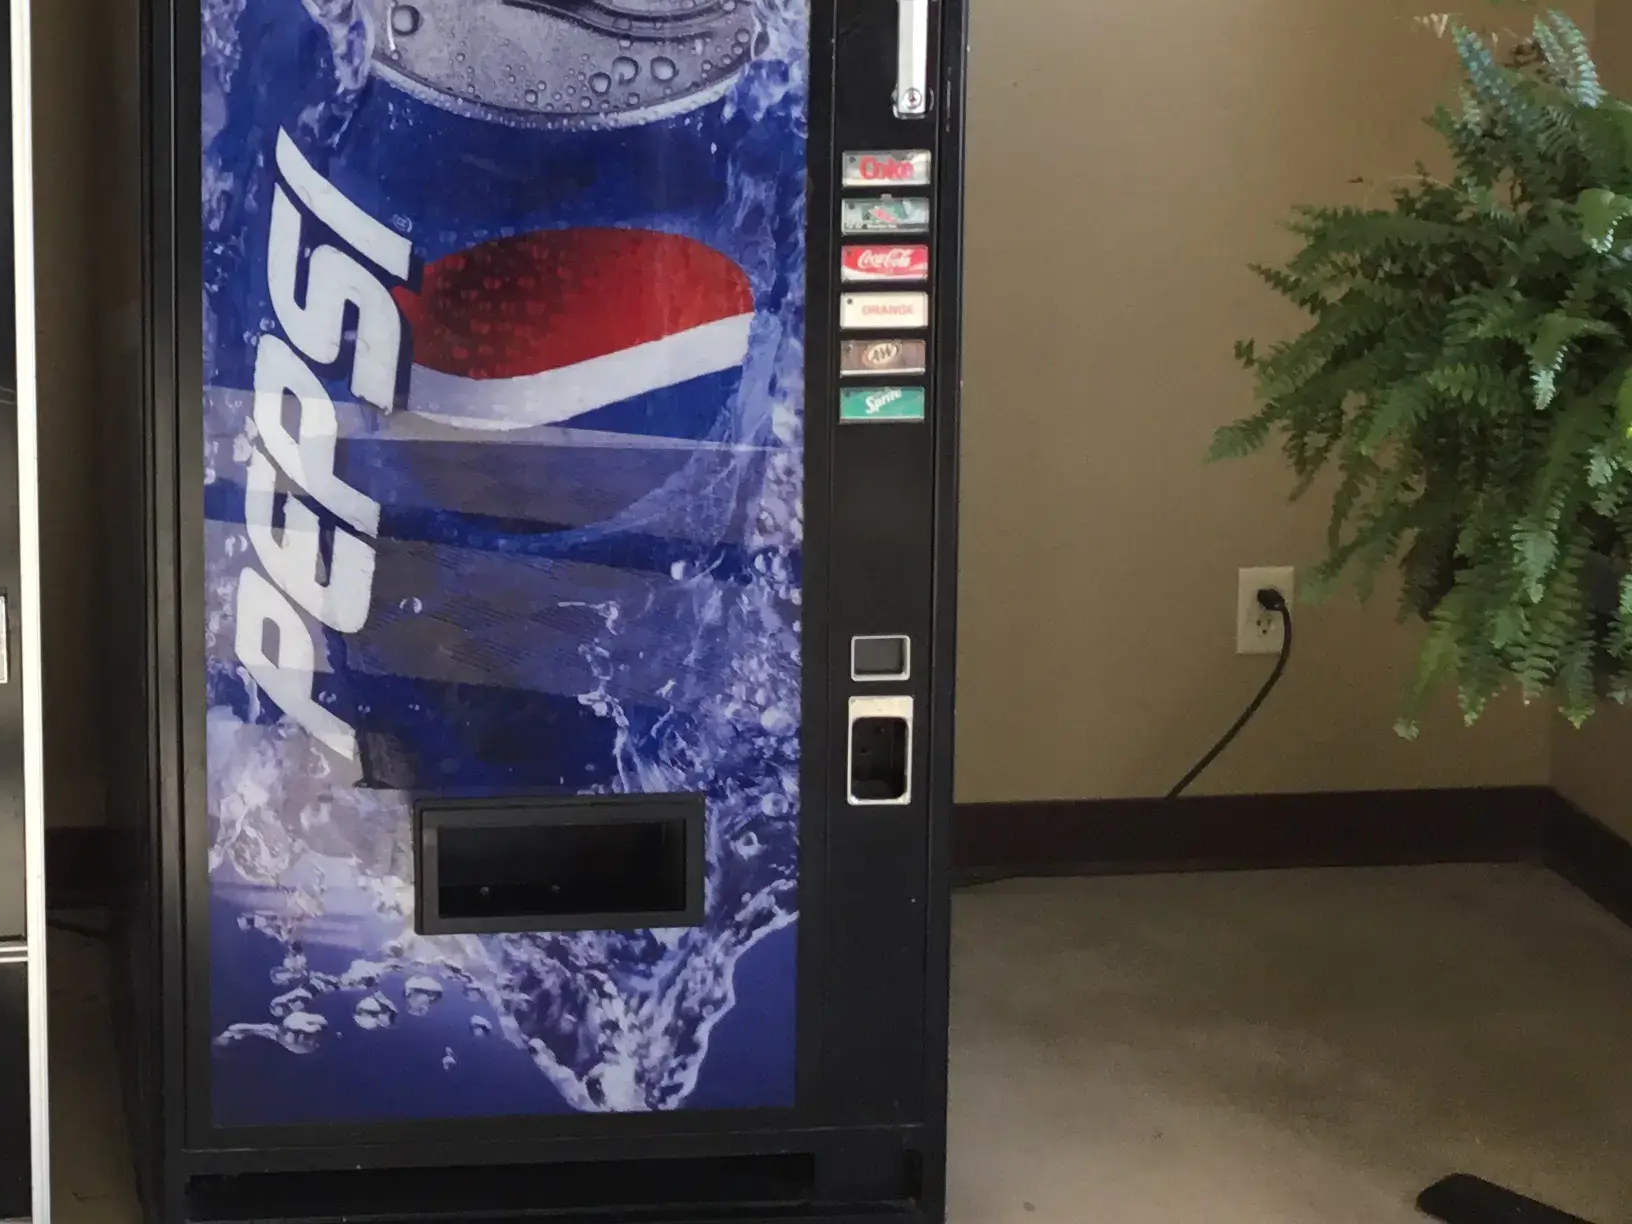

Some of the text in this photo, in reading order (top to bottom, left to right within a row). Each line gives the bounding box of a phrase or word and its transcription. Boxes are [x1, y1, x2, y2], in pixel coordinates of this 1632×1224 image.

[859, 154, 914, 180] Coke
[861, 304, 915, 316] ORANGE
[864, 389, 903, 414] Sprite
[234, 126, 413, 761] PEPSI
